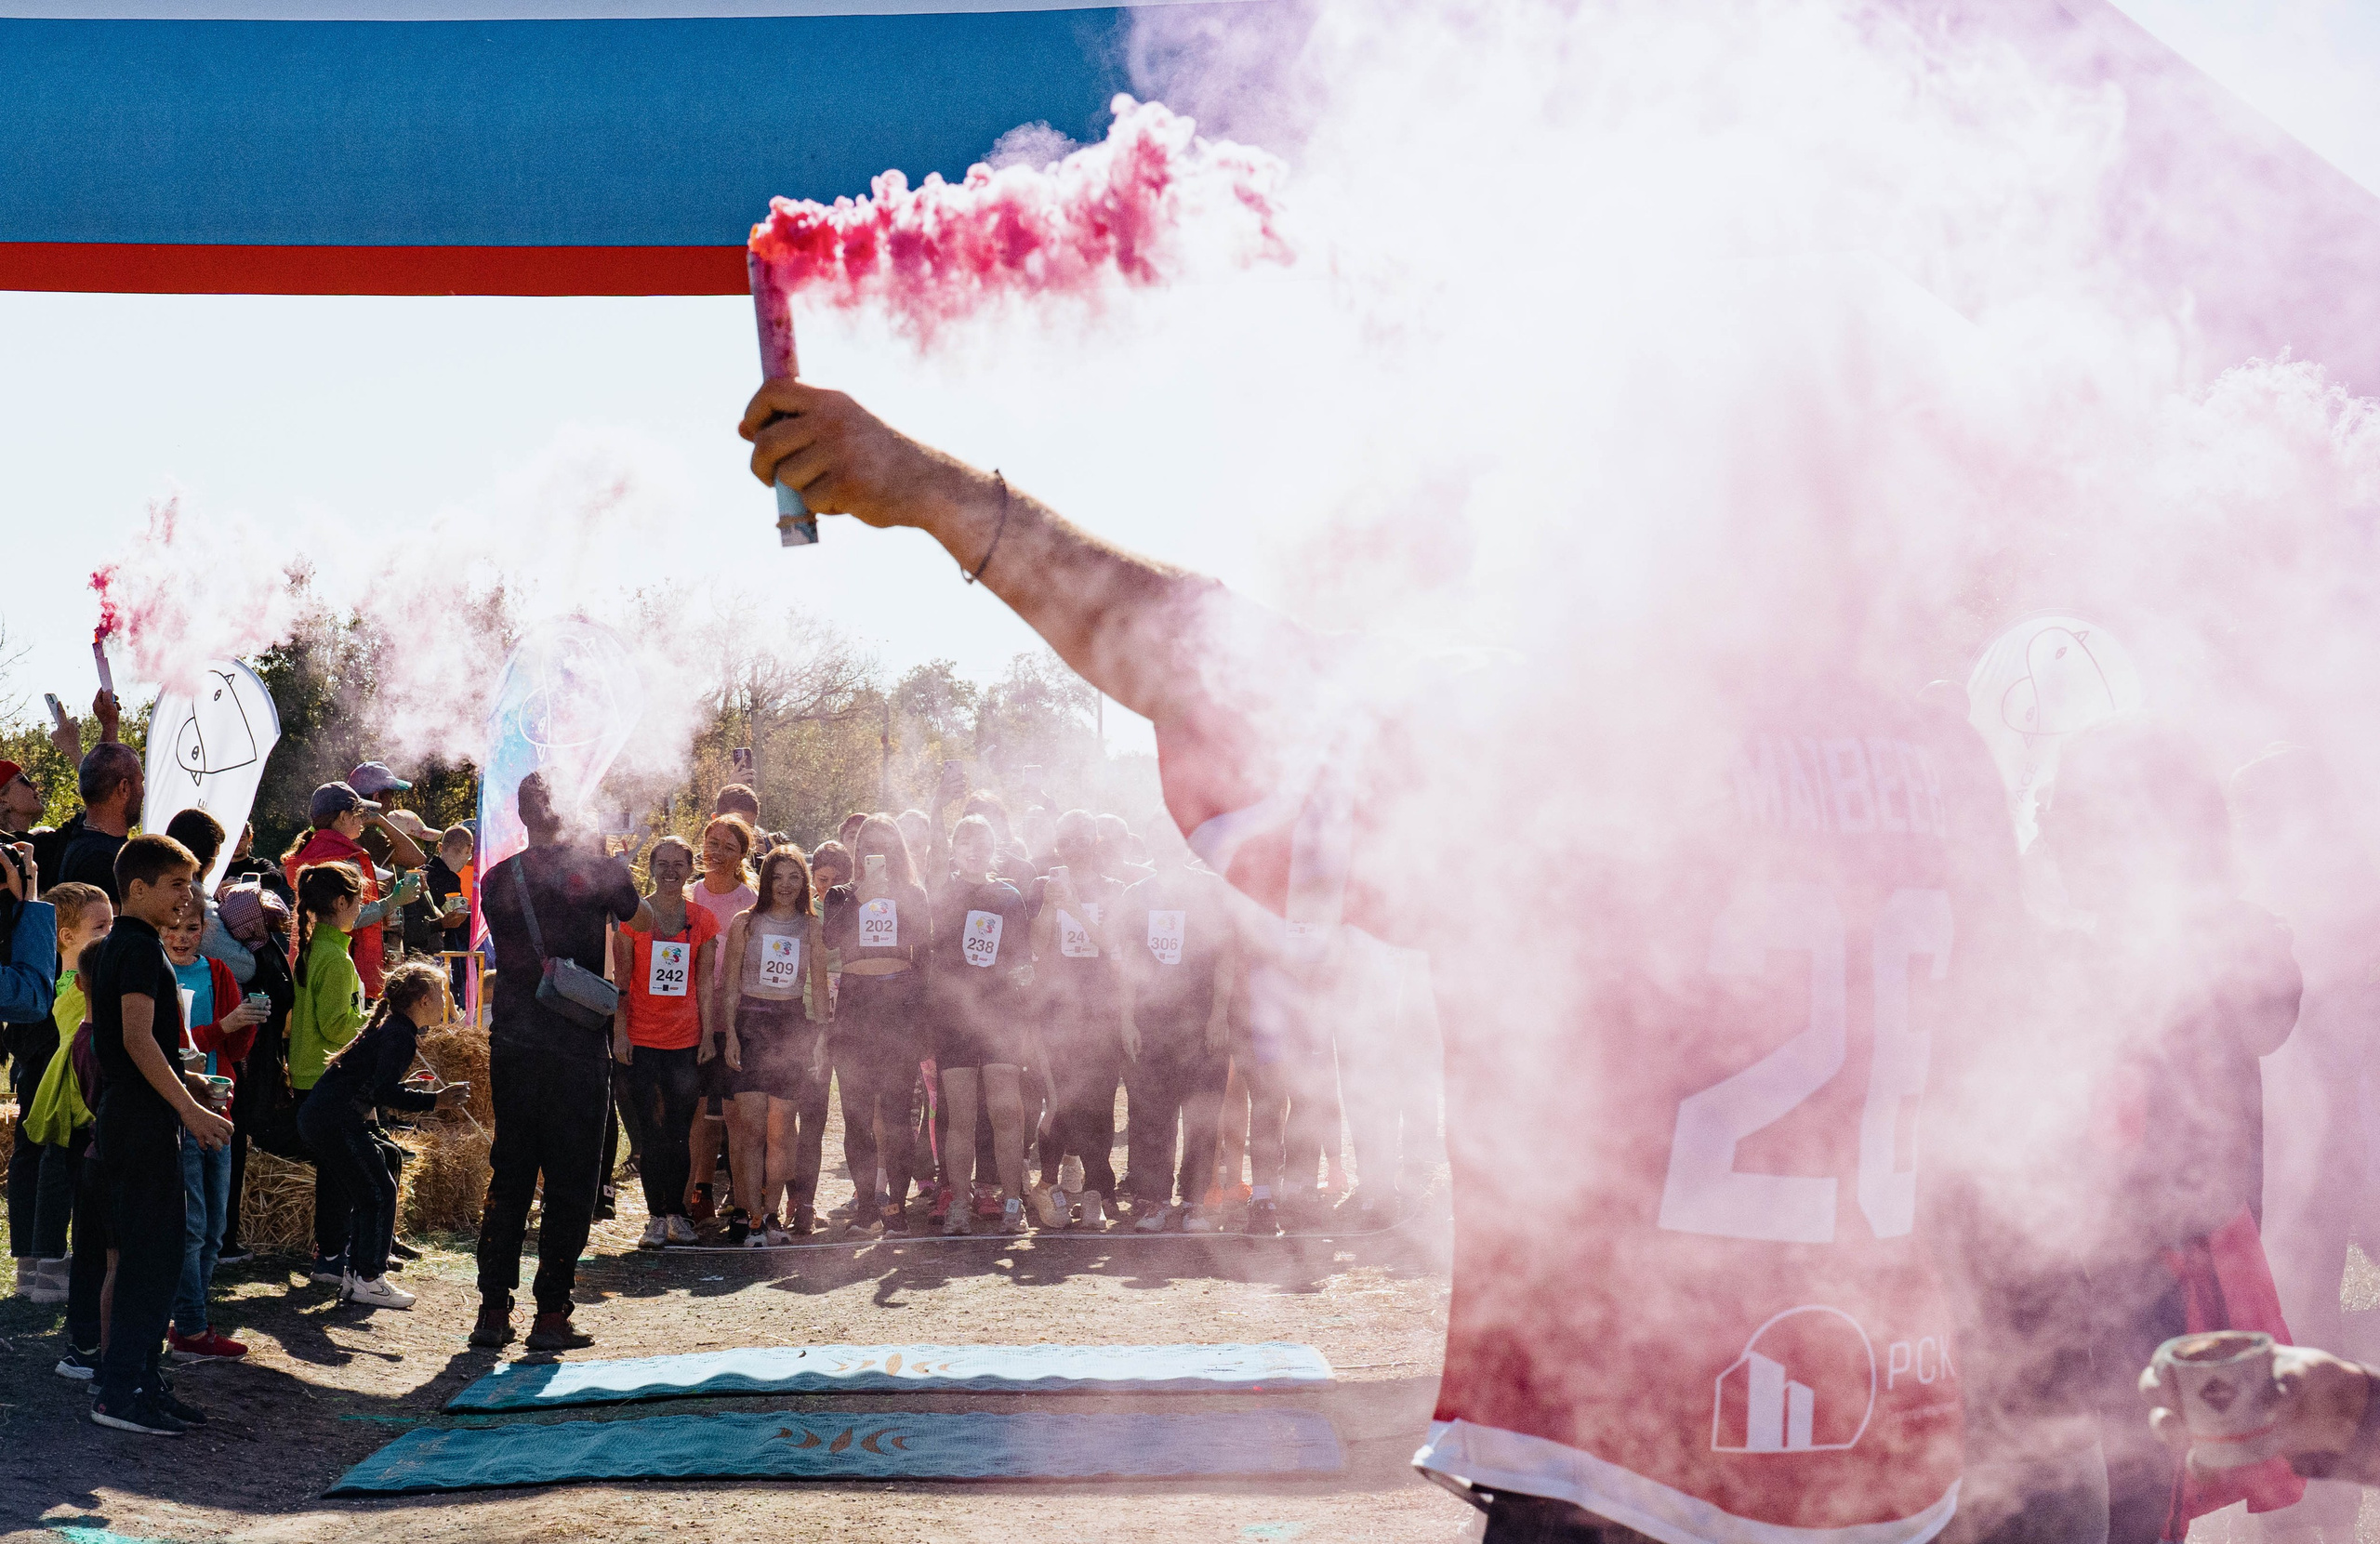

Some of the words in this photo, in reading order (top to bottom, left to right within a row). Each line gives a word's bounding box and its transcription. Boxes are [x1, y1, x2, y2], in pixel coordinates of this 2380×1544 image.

[866, 919, 893, 932] 202
[1067, 930, 1087, 944] 24
[1151, 937, 1178, 950] 306
[967, 937, 995, 954] 238
[766, 960, 794, 975] 209
[655, 969, 683, 983] 242
